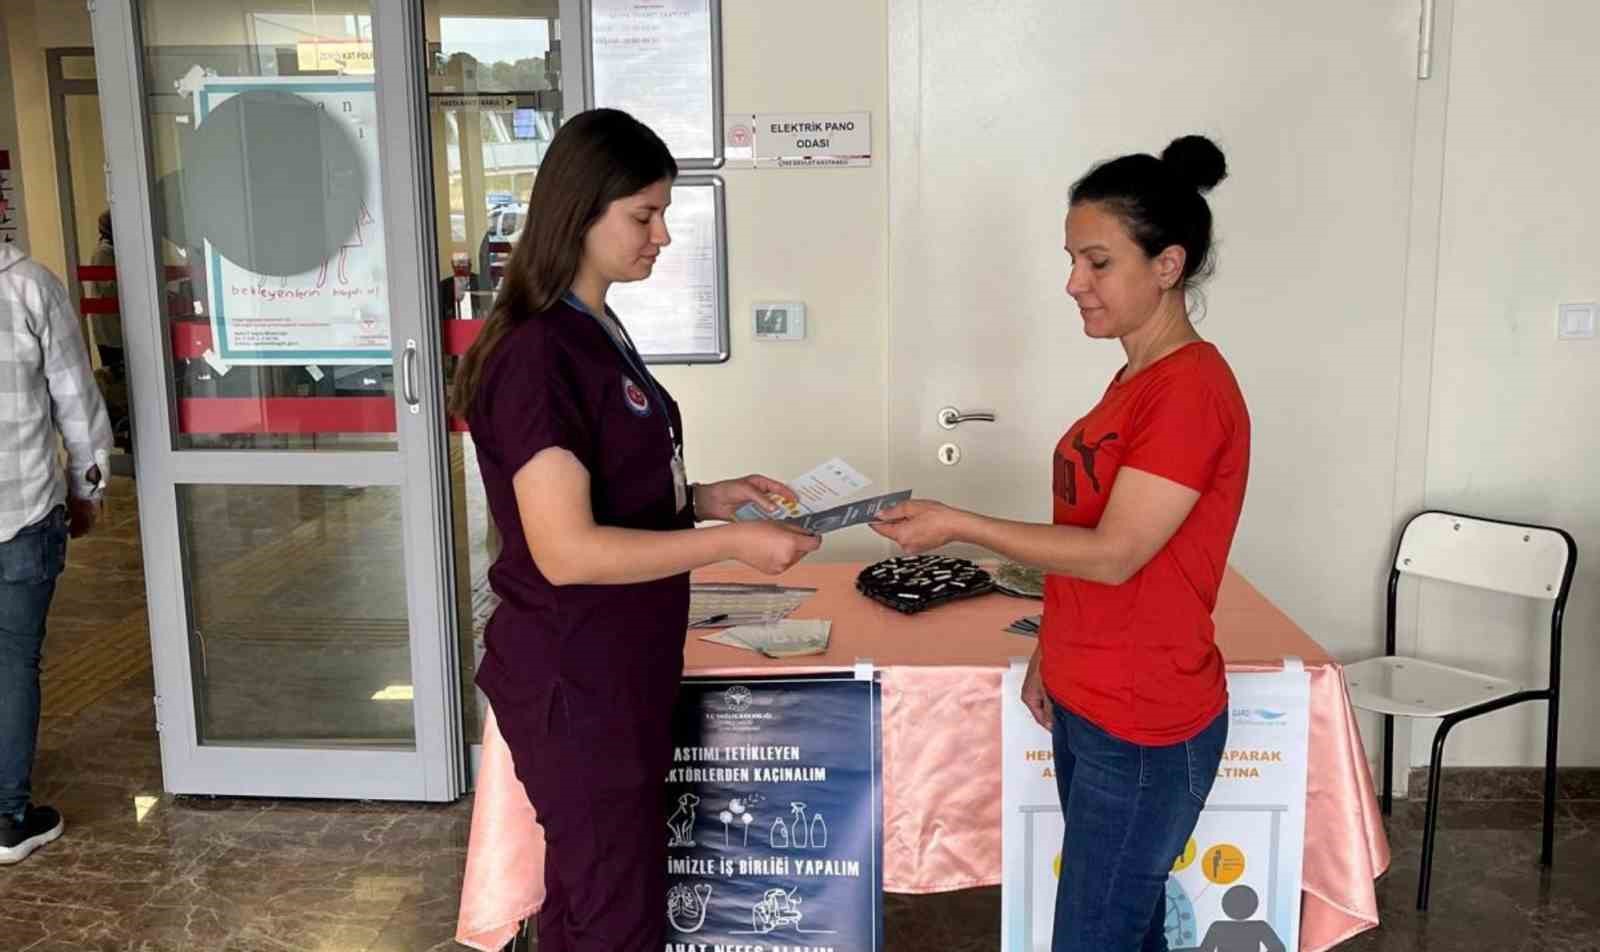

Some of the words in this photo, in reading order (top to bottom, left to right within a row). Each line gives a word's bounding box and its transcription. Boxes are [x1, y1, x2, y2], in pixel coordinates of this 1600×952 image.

[770, 120, 823, 133] ELEKTRİK
[825, 121, 855, 131] PANO
[796, 138, 830, 149] ODASI
[673, 747, 720, 762] ASTIMI
[723, 744, 801, 761] TETİKLEYEN
[664, 767, 750, 783] KTÖRLERDEN
[753, 767, 827, 784] KAÇINALIM
[720, 856, 734, 878] İŞ
[739, 856, 790, 876] BİRLİĞİ
[795, 859, 860, 877] YAPALIM
